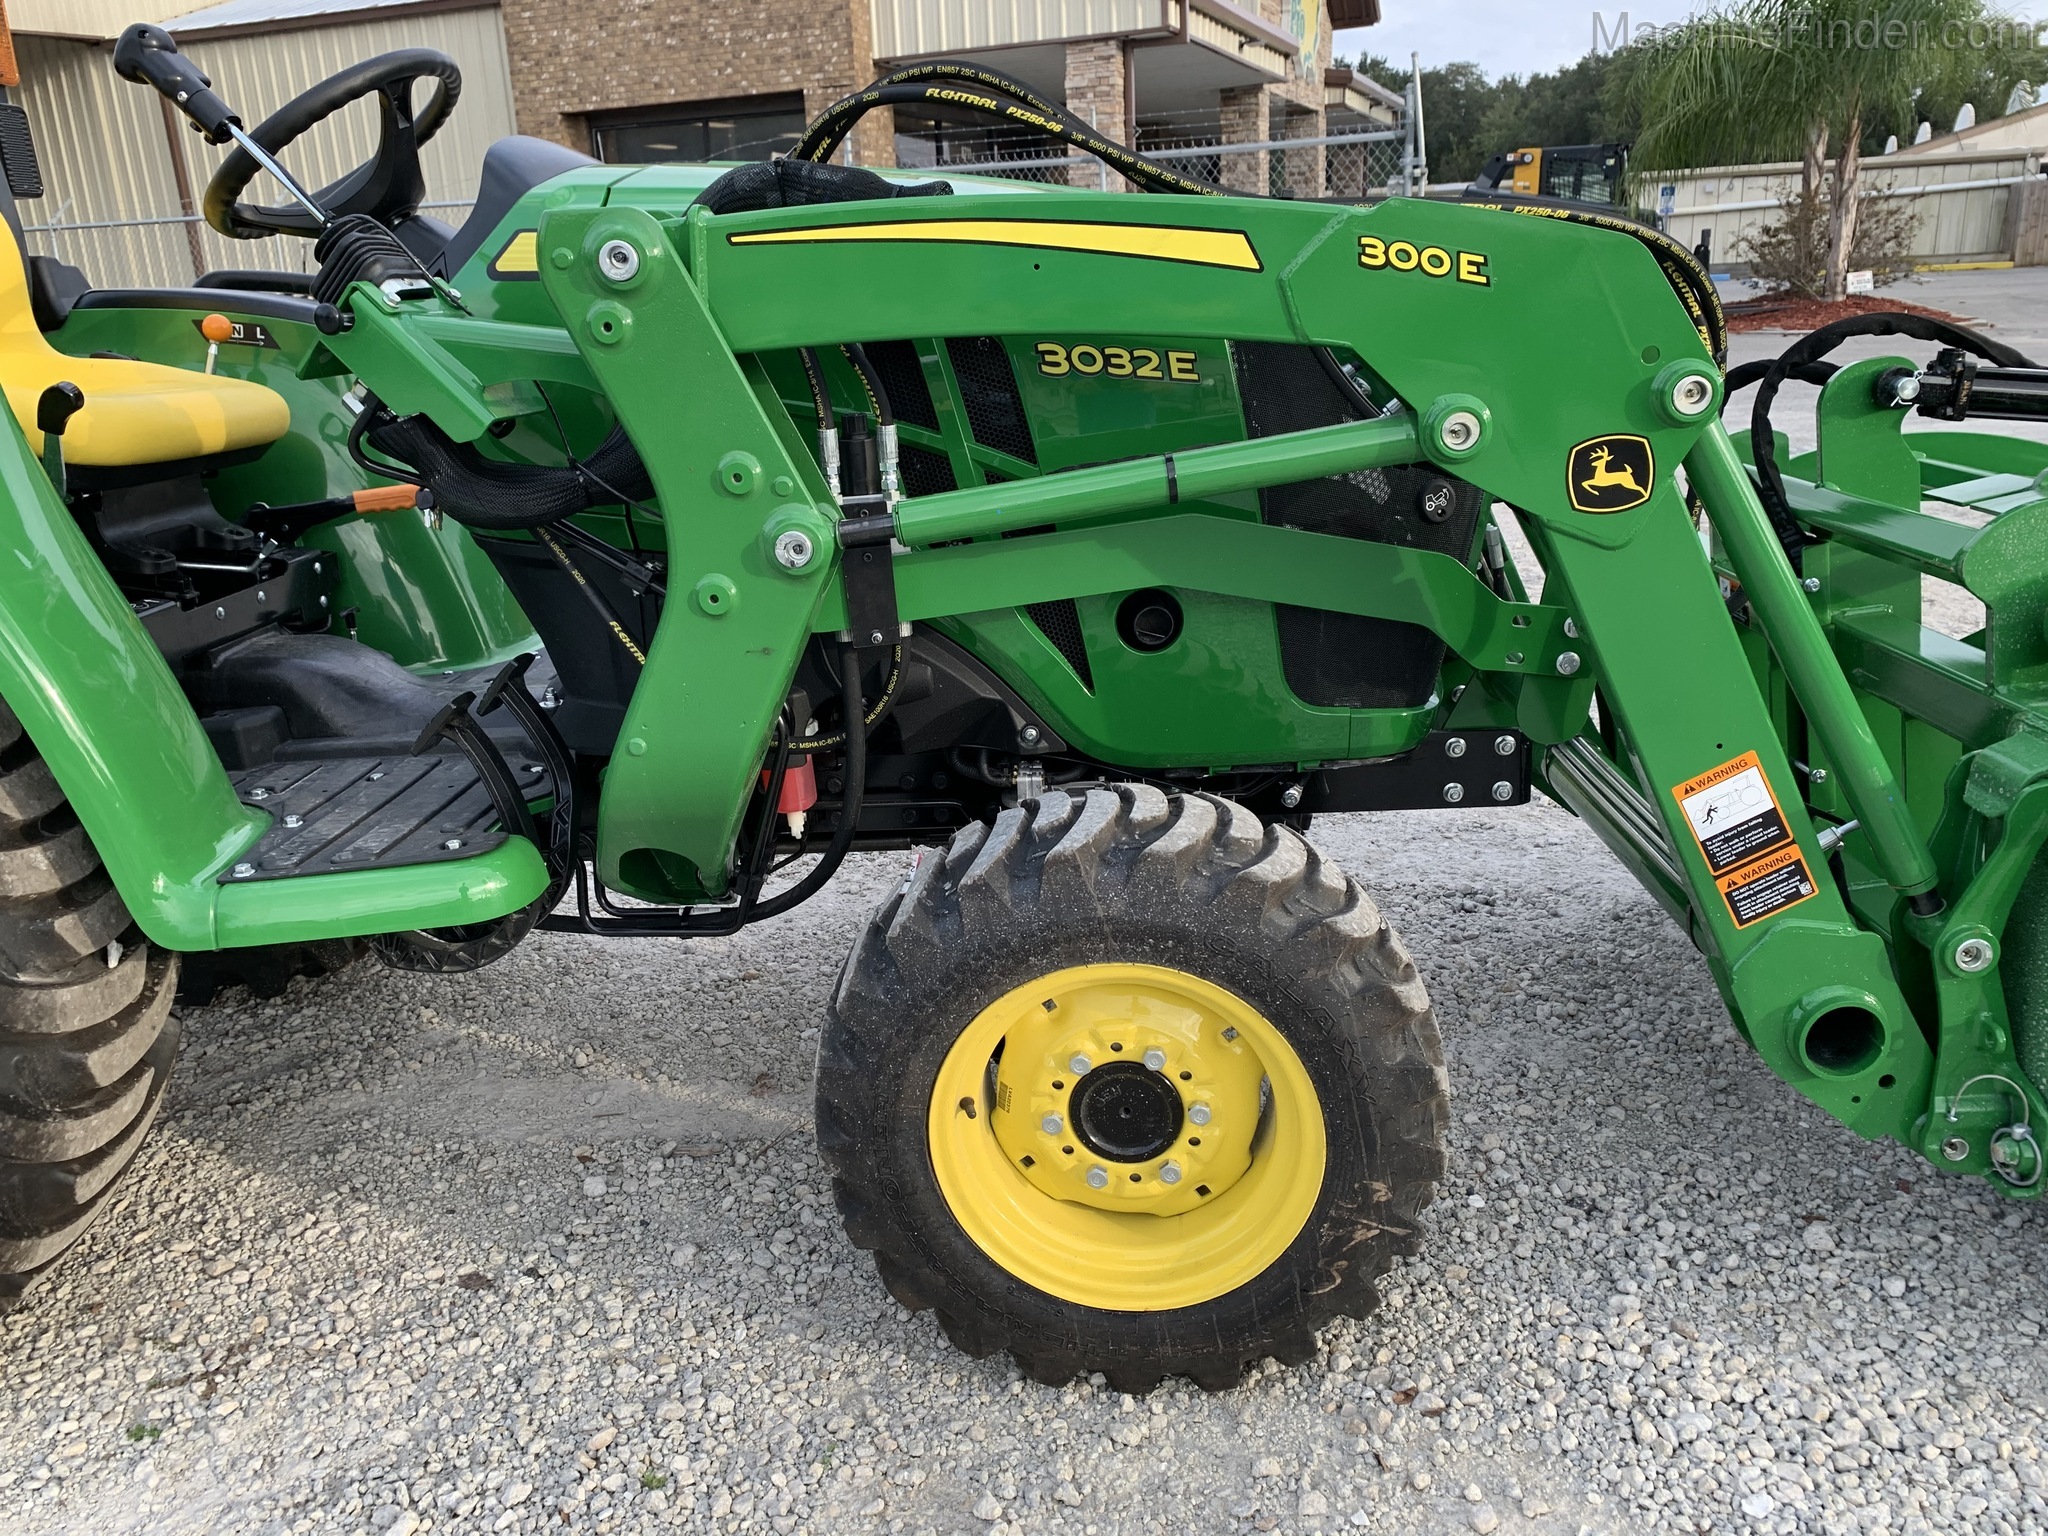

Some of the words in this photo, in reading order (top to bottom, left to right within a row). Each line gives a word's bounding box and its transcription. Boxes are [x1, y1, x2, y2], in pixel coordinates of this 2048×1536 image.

[892, 71, 909, 83] 5000
[908, 67, 921, 77] PSI
[921, 65, 933, 75] WP
[936, 65, 960, 75] EN857
[960, 67, 976, 78] 2SC
[978, 72, 1001, 86] MSHA
[1000, 80, 1026, 98] IC-8/14
[831, 98, 856, 116] USCG-H
[862, 91, 880, 102] 2Q20
[925, 87, 999, 111] FLEXTRAL
[1006, 105, 1065, 133] PX250-06
[1070, 131, 1086, 142] 3/8"
[1088, 139, 1107, 153] 5000
[1107, 147, 1120, 159] PSI
[1121, 152, 1135, 164] WP
[1136, 161, 1161, 175] EN857
[1161, 171, 1177, 184] 2SC
[1179, 178, 1202, 194] MSHA
[1513, 205, 1571, 219] PX250-06
[1595, 216, 1612, 227] 5000
[1611, 219, 1625, 230] PSI
[1625, 222, 1637, 232] WP
[1657, 237, 1671, 248] 2SC
[1670, 244, 1686, 259] MSHA
[1719, 328, 1727, 351] USCG-
[256, 326, 265, 339] L
[571, 568, 586, 585] 2Q20
[799, 741, 819, 749] MSHA
[1695, 758, 1748, 788] WARNING
[1740, 852, 1793, 881] WARNING
